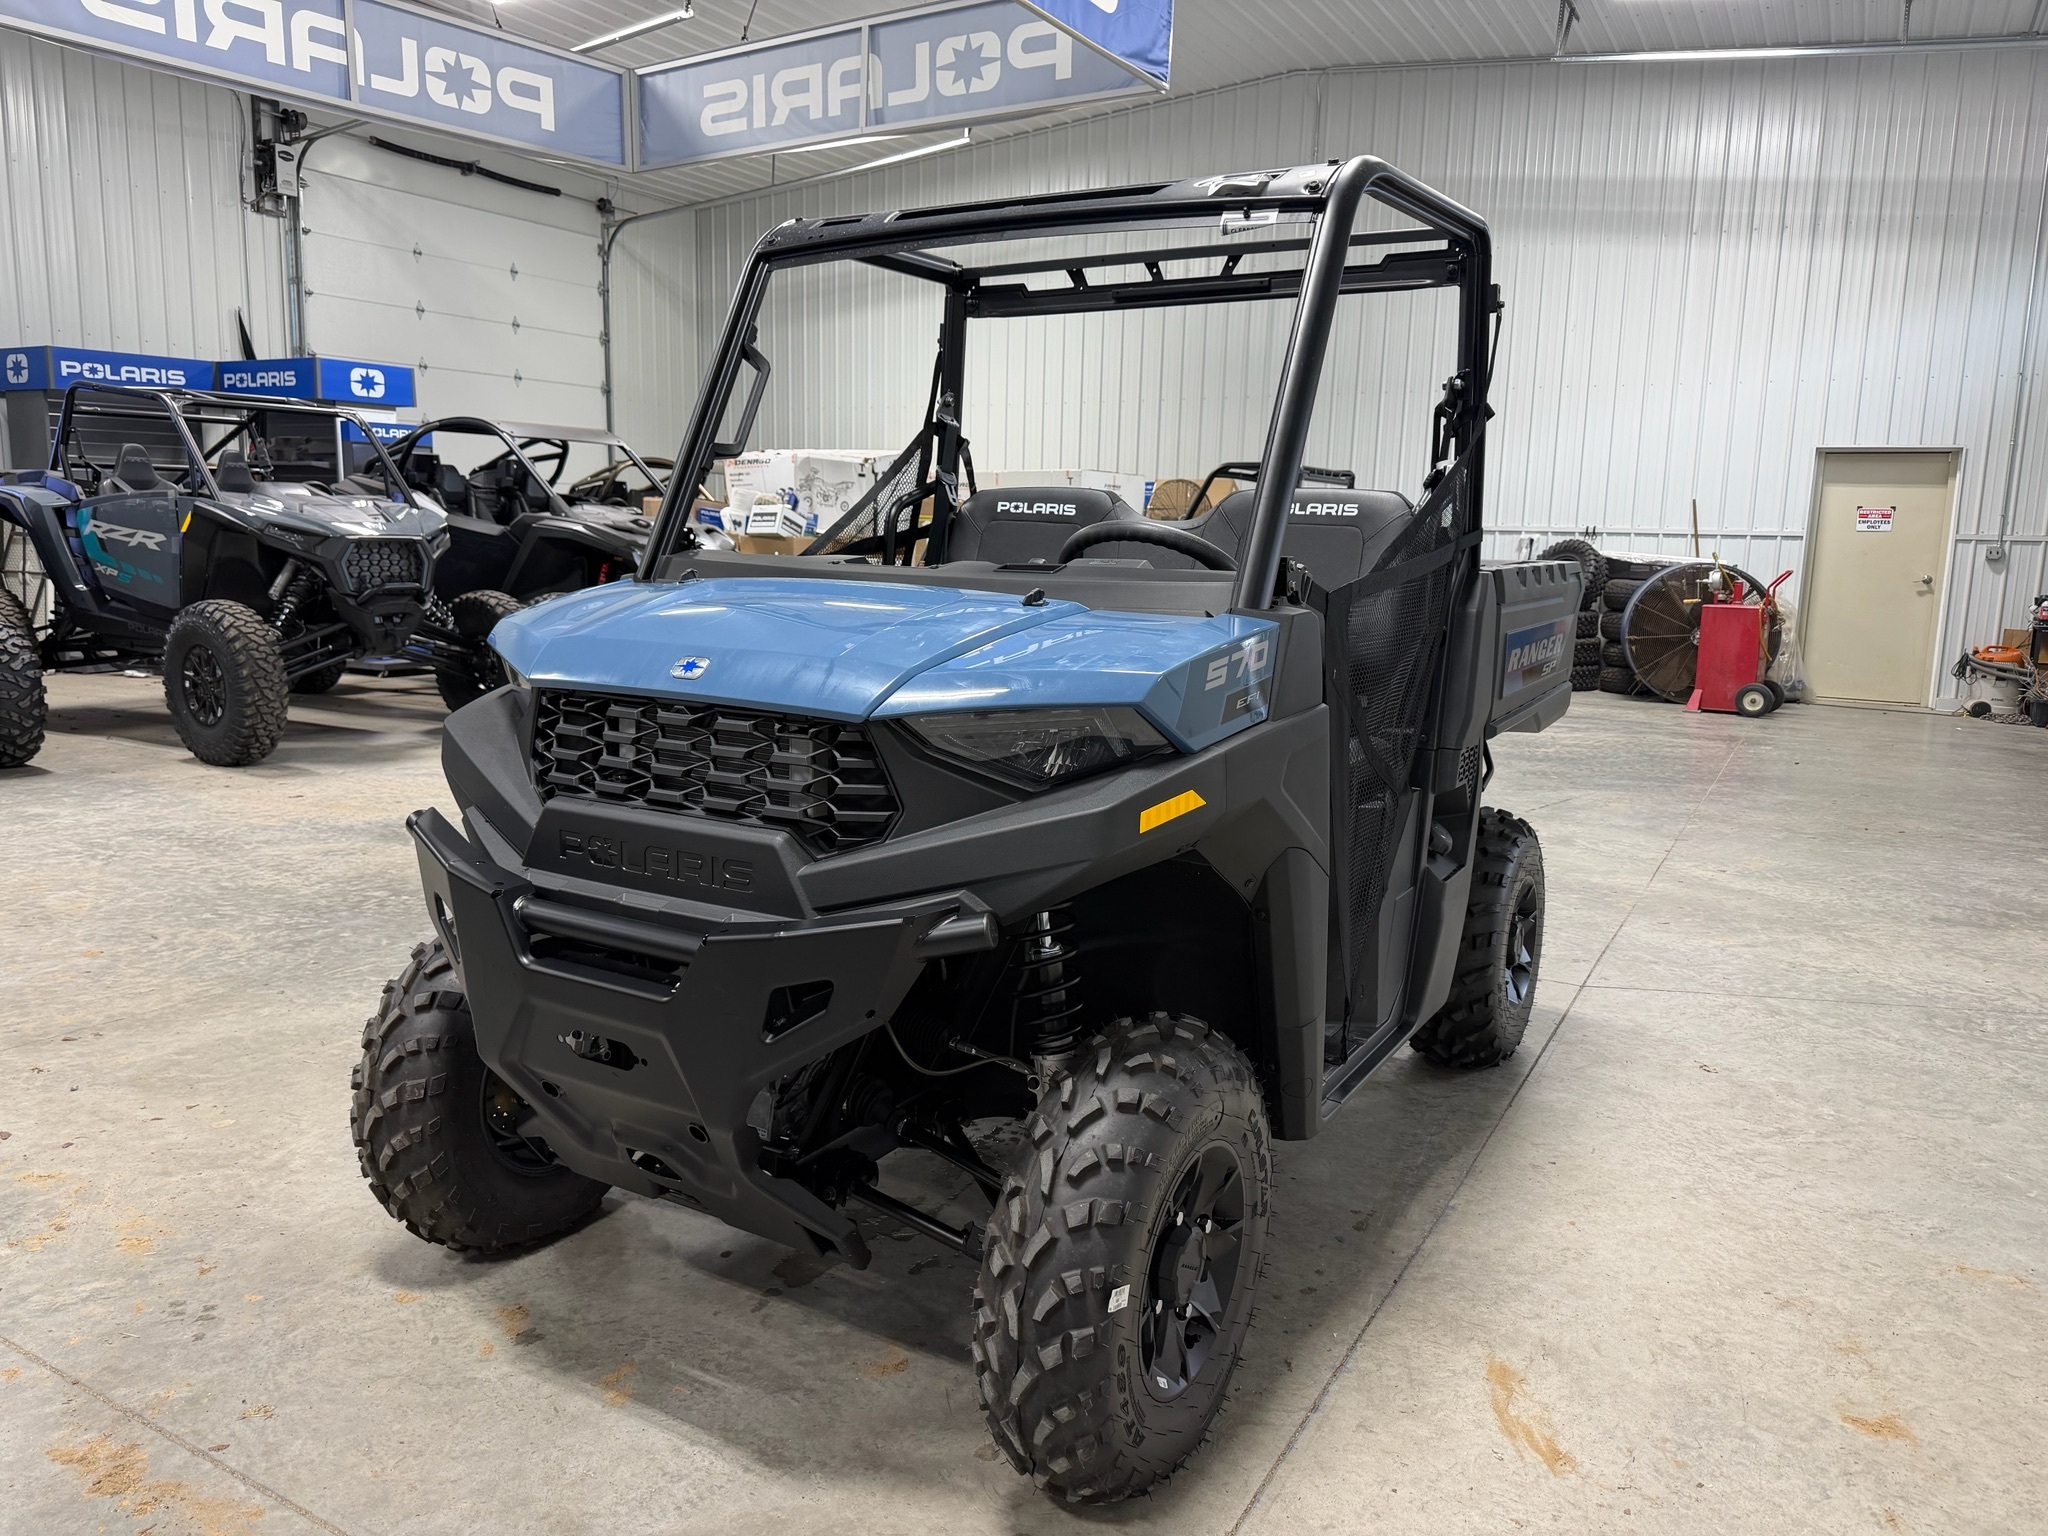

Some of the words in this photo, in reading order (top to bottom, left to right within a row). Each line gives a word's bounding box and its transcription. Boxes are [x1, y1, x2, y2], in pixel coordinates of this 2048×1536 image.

[60, 360, 187, 386] POLARIS
[224, 370, 297, 388] POLARIS
[997, 501, 1077, 516] POLARIS
[1290, 503, 1359, 516] LARIS
[83, 518, 167, 551] RZR
[1507, 633, 1564, 673] RANGER
[1205, 640, 1269, 691] 570
[1541, 660, 1558, 676] SP
[1236, 691, 1260, 709] EFI
[558, 828, 754, 893] POLARIS
